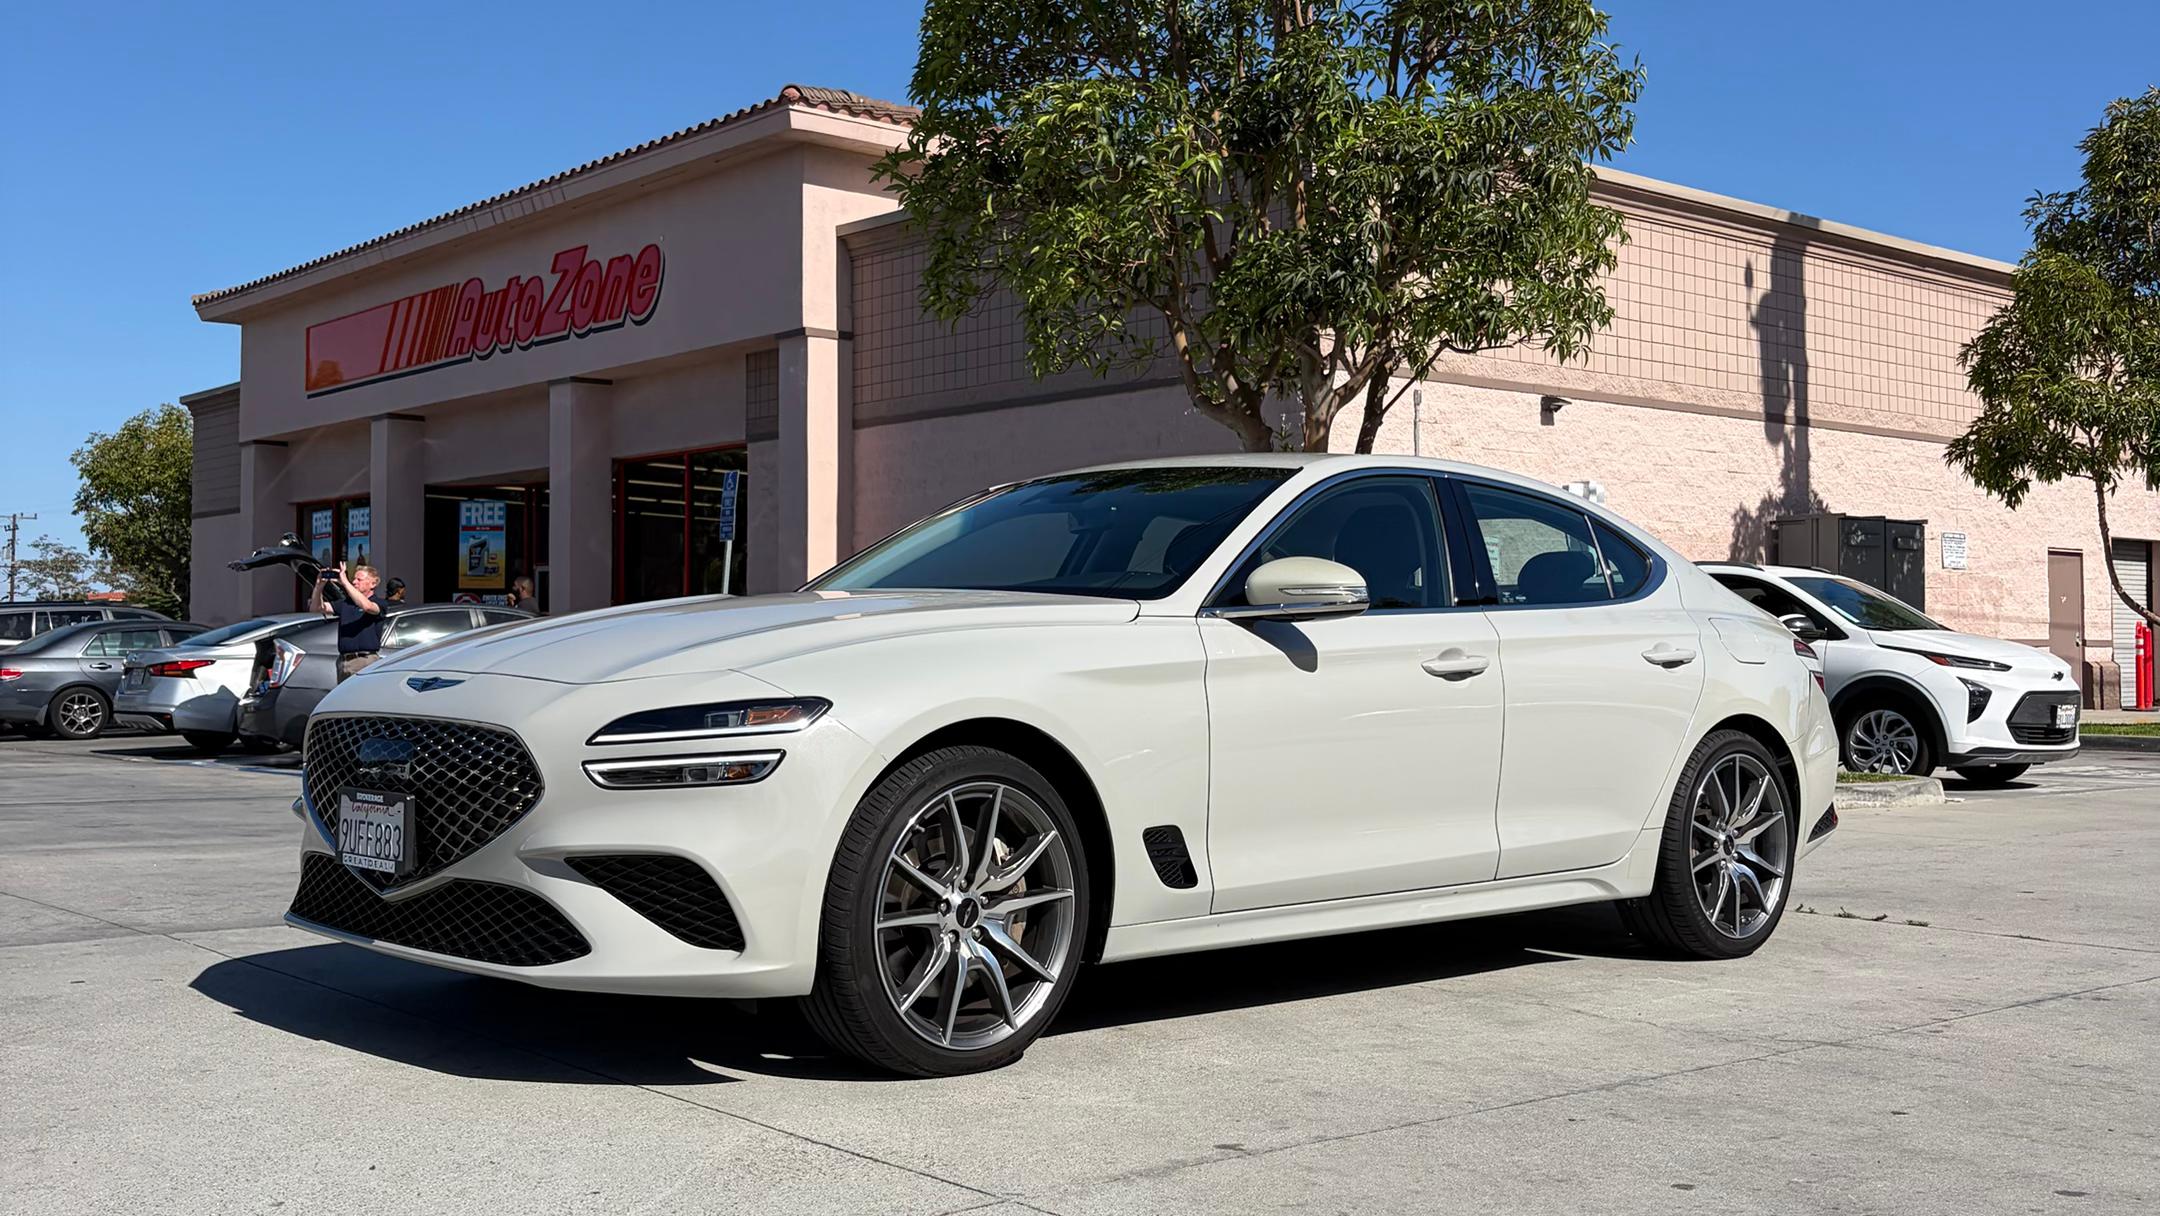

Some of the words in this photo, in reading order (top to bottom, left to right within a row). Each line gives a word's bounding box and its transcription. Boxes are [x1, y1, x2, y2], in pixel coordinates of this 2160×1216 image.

[450, 243, 662, 357] AutoZone
[313, 511, 332, 533] FREE
[349, 508, 369, 532] FREE
[460, 502, 505, 525] FREE
[341, 818, 402, 860] 9UFF883
